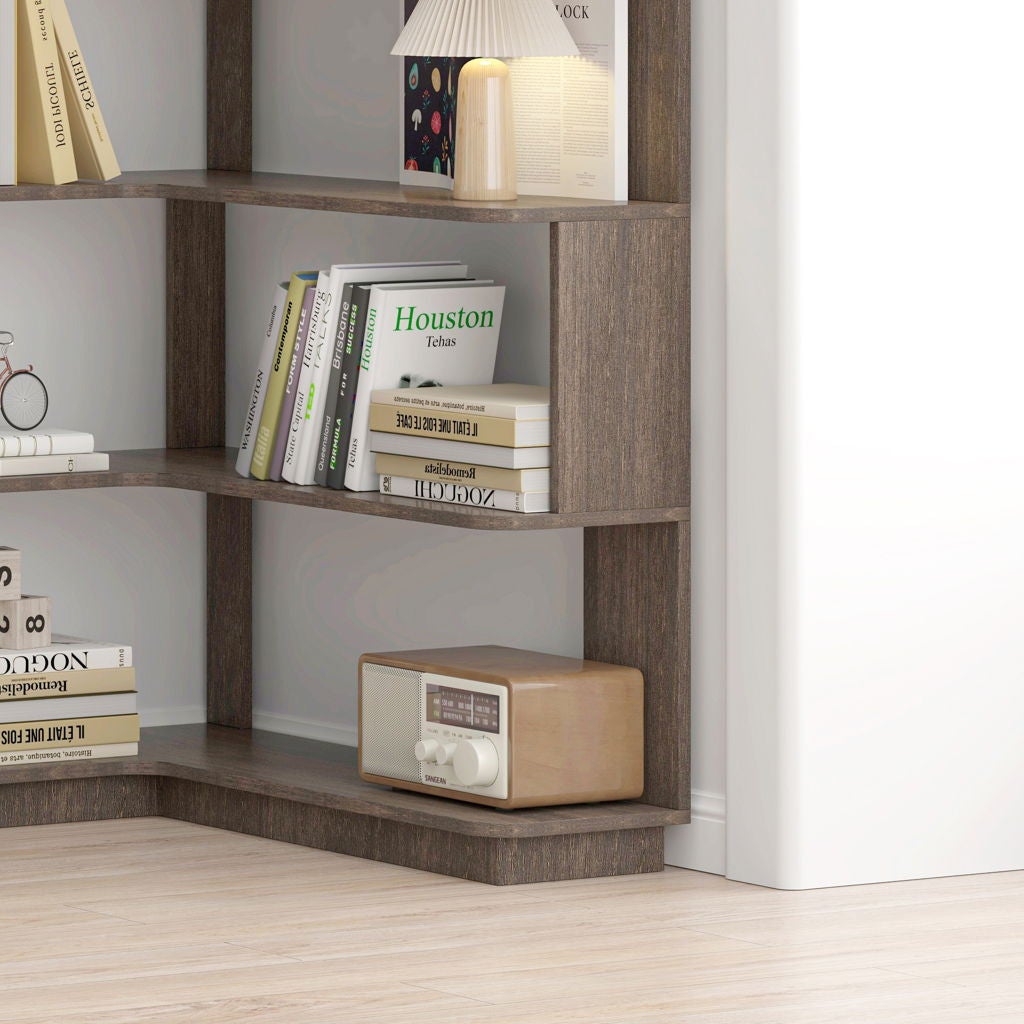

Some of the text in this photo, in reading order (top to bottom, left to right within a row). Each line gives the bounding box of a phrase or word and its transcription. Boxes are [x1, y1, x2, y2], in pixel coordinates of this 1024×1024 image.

[274, 301, 293, 372] Contemporan
[286, 308, 307, 394] FORM STYLE
[332, 301, 350, 370] Brisbane
[360, 308, 377, 371] Houston
[392, 305, 495, 332] Houston
[425, 335, 457, 348] Tehas
[241, 367, 264, 450] WASHINGTON
[329, 303, 358, 470] FORMULA FOR SUCCESS
[318, 415, 331, 471] Queensland
[26, 614, 46, 633] 8
